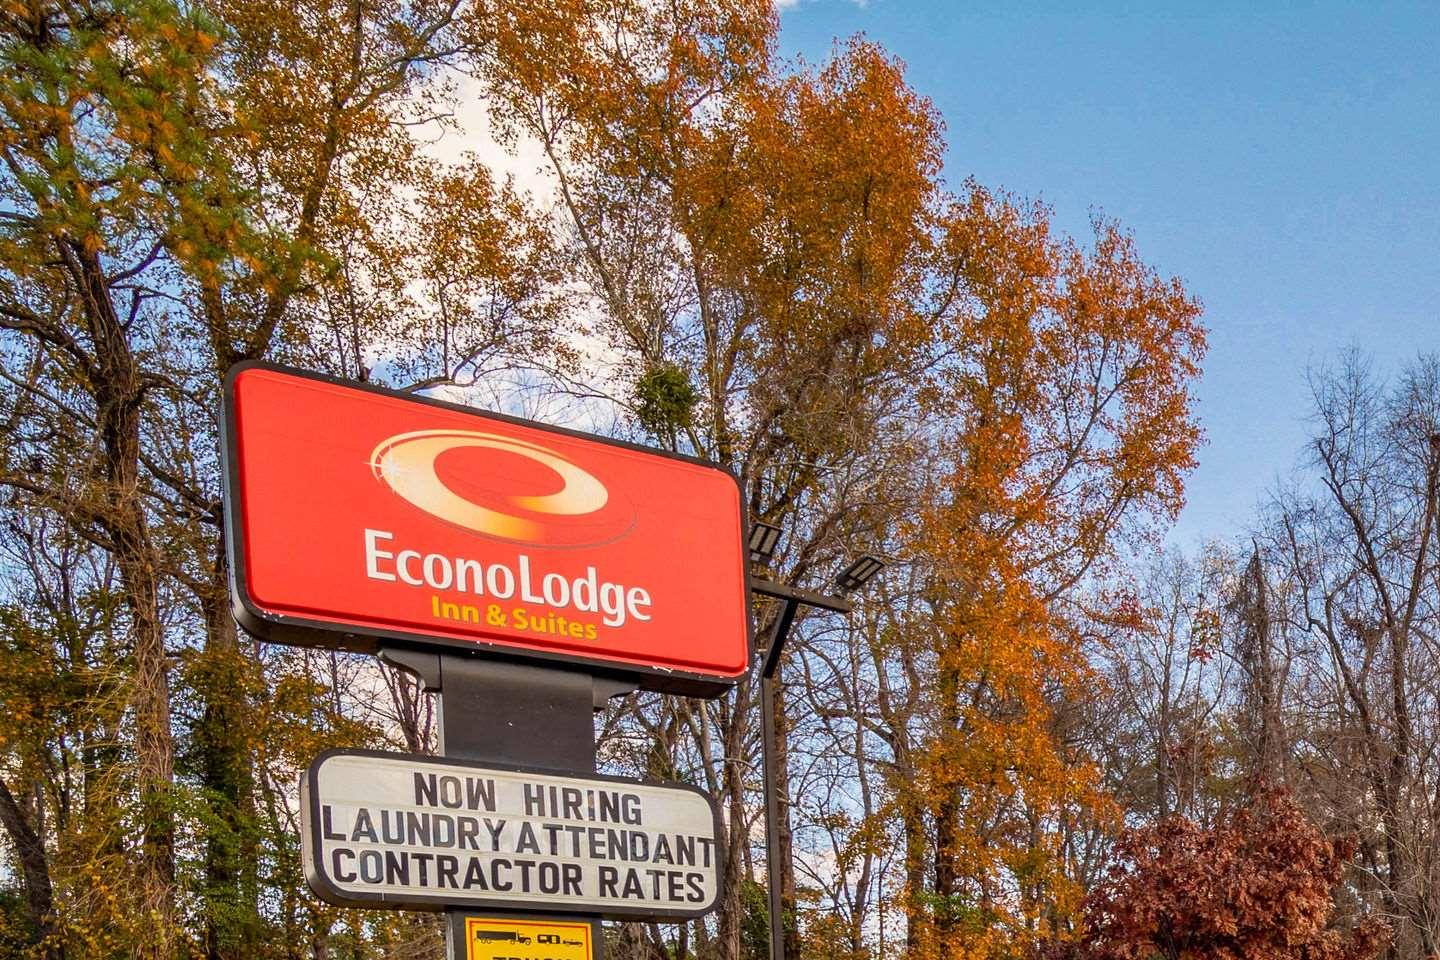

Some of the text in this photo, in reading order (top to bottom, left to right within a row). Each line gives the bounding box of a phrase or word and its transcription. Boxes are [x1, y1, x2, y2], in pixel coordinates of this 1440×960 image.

[364, 528, 652, 628] EconoLodge
[431, 595, 598, 640] Inn & Suites
[413, 772, 642, 826] NOW HIRING
[322, 805, 715, 868] LAUNDRY ATTENDANT
[331, 848, 705, 903] CONTRACTOR RATES
